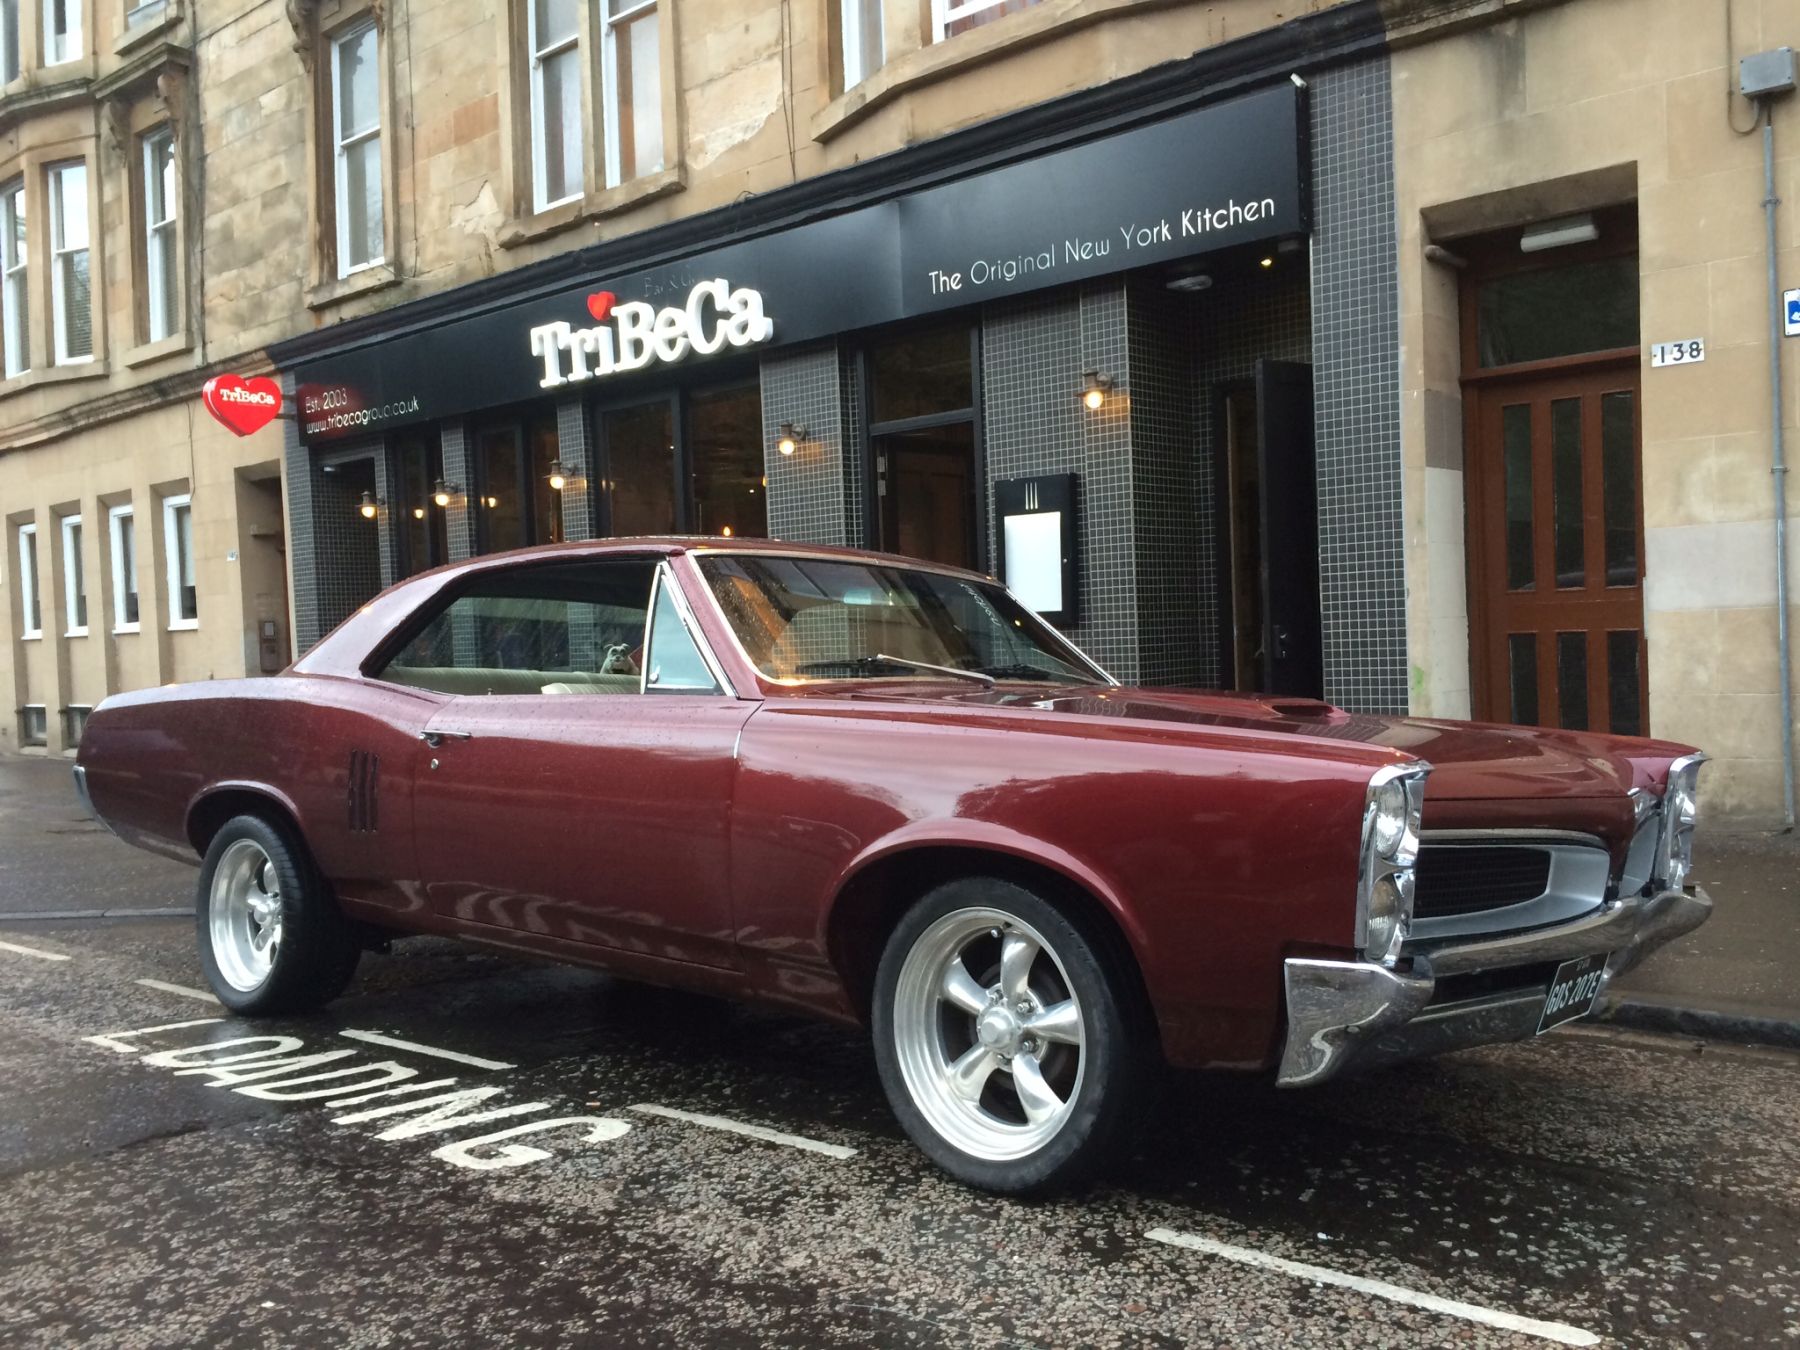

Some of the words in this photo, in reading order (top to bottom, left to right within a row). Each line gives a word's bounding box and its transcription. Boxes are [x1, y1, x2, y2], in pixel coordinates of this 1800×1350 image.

[929, 270, 962, 296] The
[970, 244, 1056, 285] Original
[1065, 238, 1111, 264] New
[1120, 219, 1172, 250] York
[1181, 198, 1276, 238] Kitchen
[530, 277, 774, 389] TriBeCa
[1660, 341, 1701, 363] 138
[219, 387, 276, 405] TriBeCa
[305, 396, 321, 414] Est.
[323, 388, 349, 410] 2003
[81, 1018, 632, 1171] LOADING
